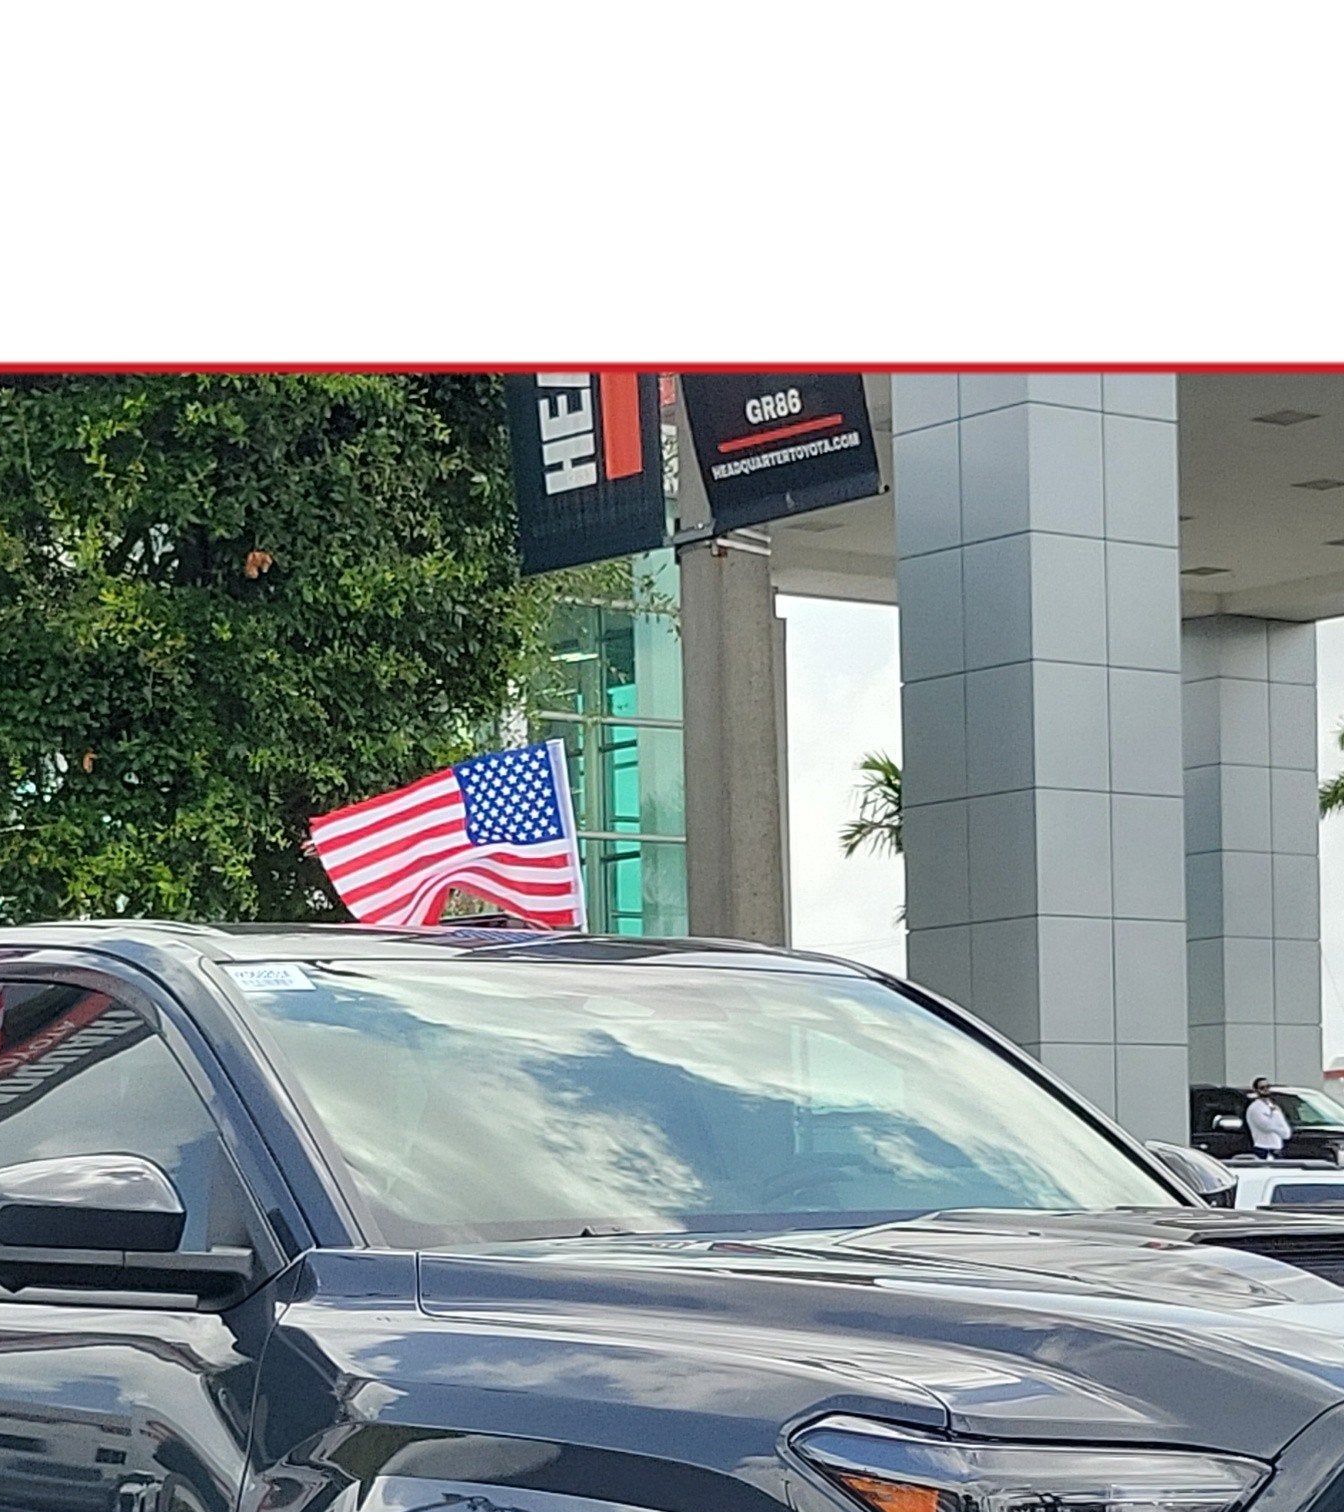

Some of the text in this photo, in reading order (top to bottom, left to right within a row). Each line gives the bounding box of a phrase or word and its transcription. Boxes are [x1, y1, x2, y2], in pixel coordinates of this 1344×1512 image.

[745, 389, 802, 424] GR86
[537, 372, 597, 496] HE
[711, 431, 860, 480] HEADQUARTERTOYOTA.COM
